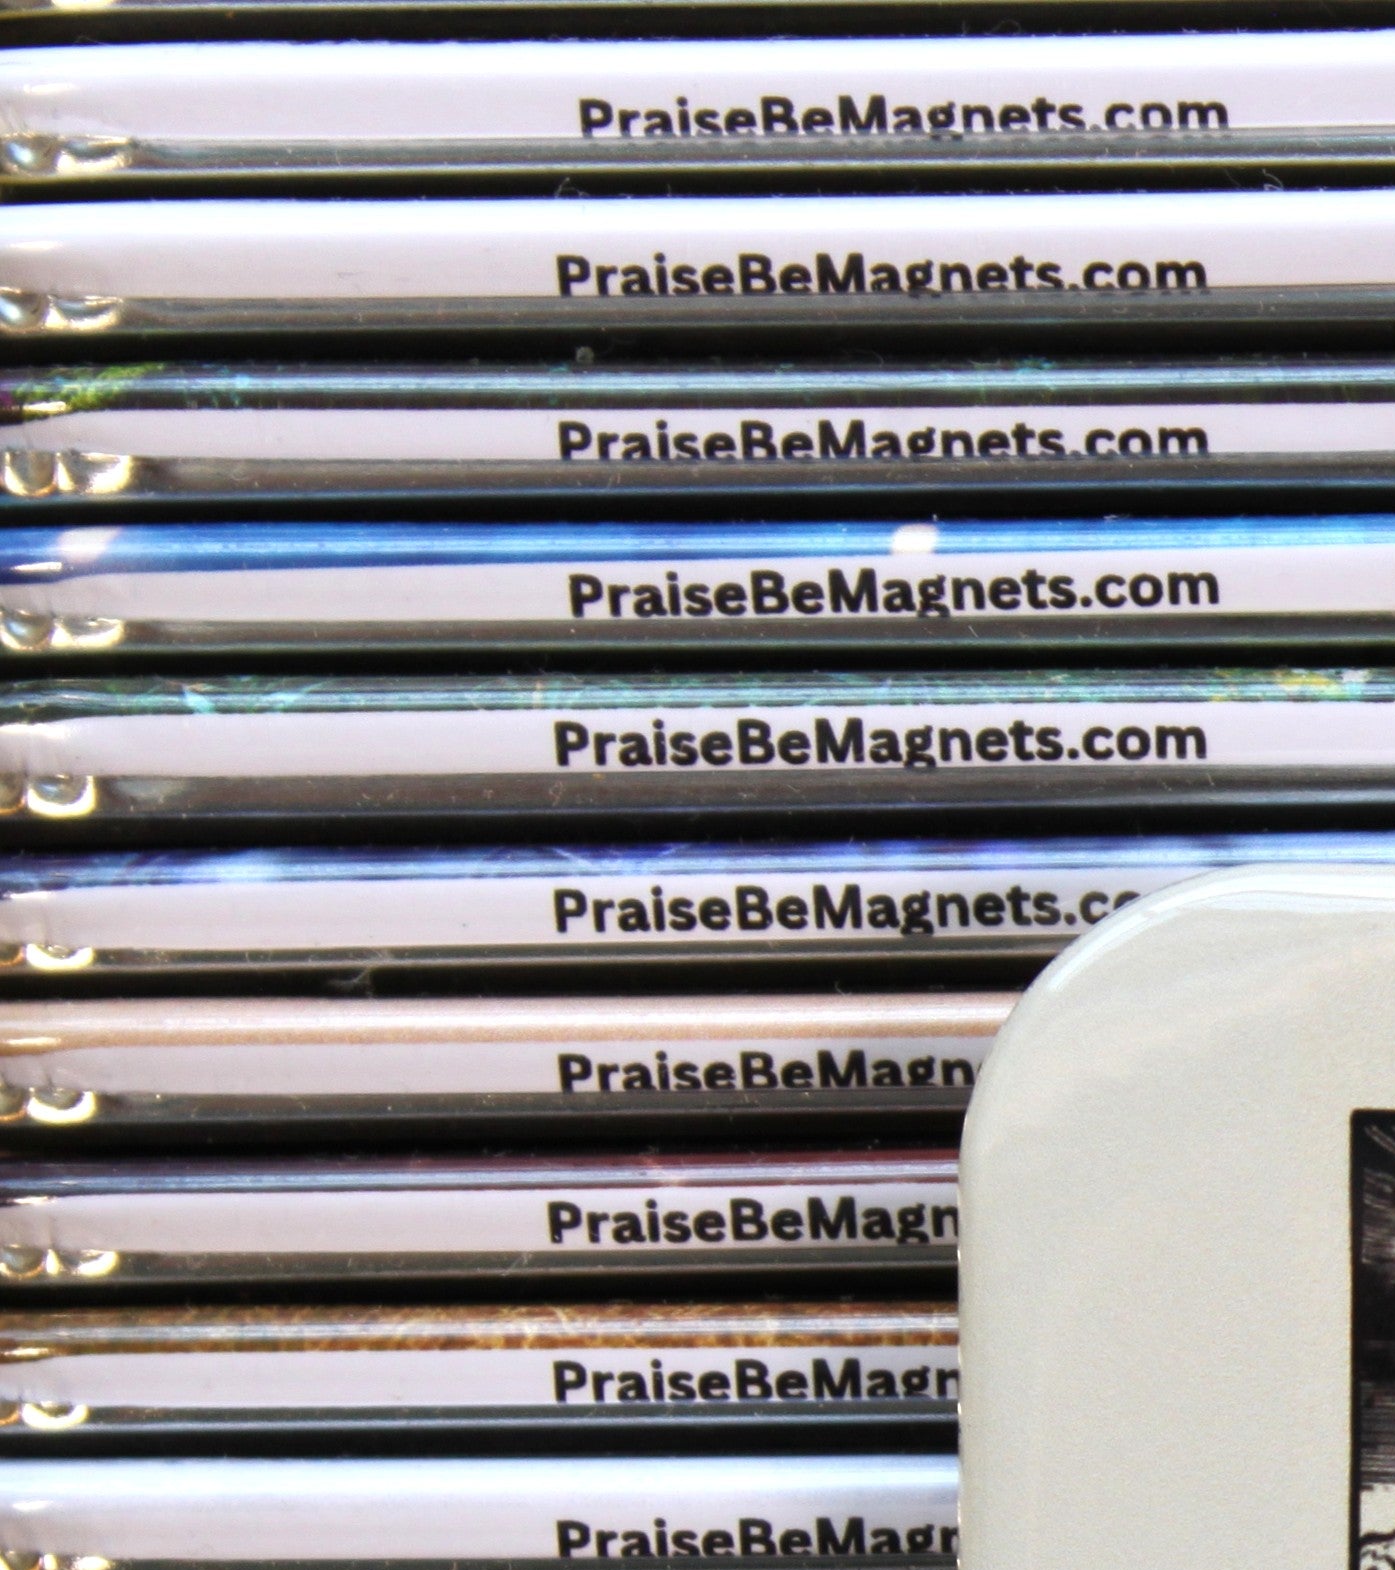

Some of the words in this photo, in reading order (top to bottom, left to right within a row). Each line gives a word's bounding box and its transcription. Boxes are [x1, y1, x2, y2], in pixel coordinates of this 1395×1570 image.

[557, 252, 1207, 297] PraiseBeMagnets.com
[569, 566, 1219, 617] PraiseBeMagnets.com
[554, 717, 1207, 767] PraiseBeMagnets.com
[554, 884, 1141, 935] PraiseBeMagnets.c
[558, 1049, 977, 1092] PraiseBeMagn
[549, 1197, 960, 1245] PraiseBeMagn
[553, 1359, 960, 1402] PraiseBeMagn
